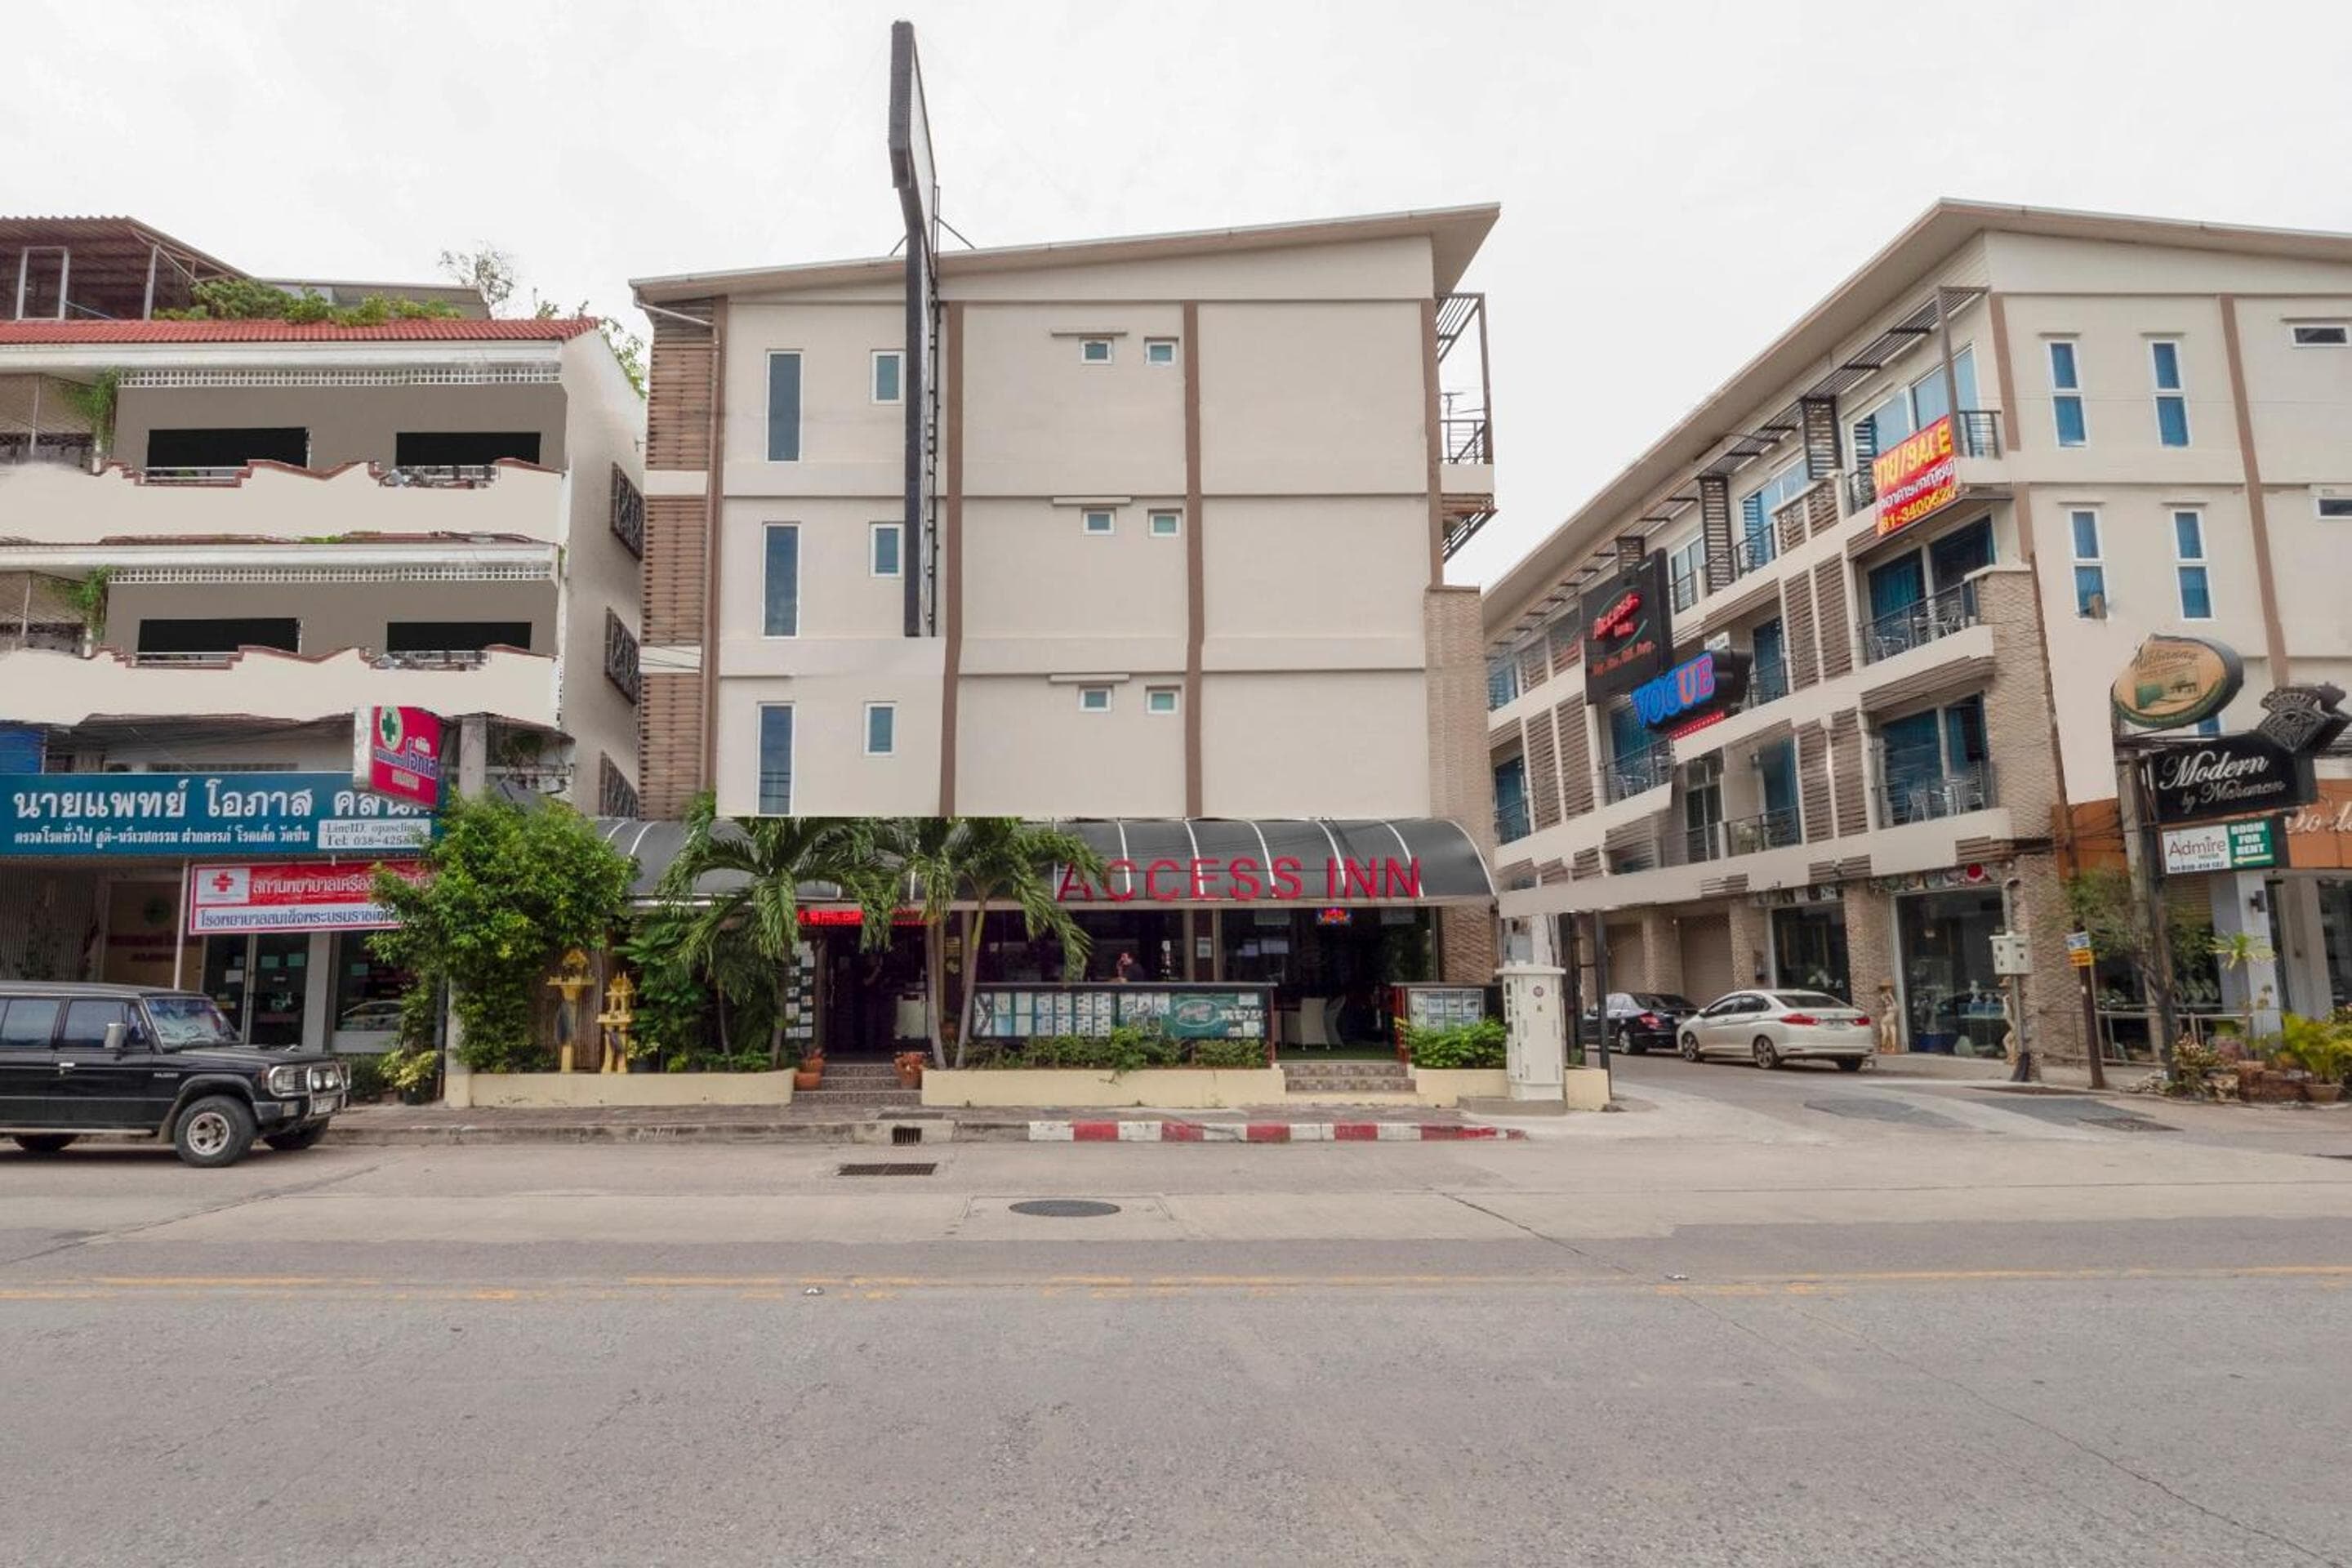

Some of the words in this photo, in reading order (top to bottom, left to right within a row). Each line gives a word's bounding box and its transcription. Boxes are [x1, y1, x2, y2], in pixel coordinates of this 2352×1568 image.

[1633, 657, 1714, 727] VOGUE
[2158, 751, 2269, 790] Modern
[13, 779, 189, 819] นายแพทย์
[205, 778, 314, 818] โอภาส
[2168, 839, 2227, 856] Admire
[1058, 857, 1304, 902] ACCESS
[1326, 857, 1421, 900] INN
